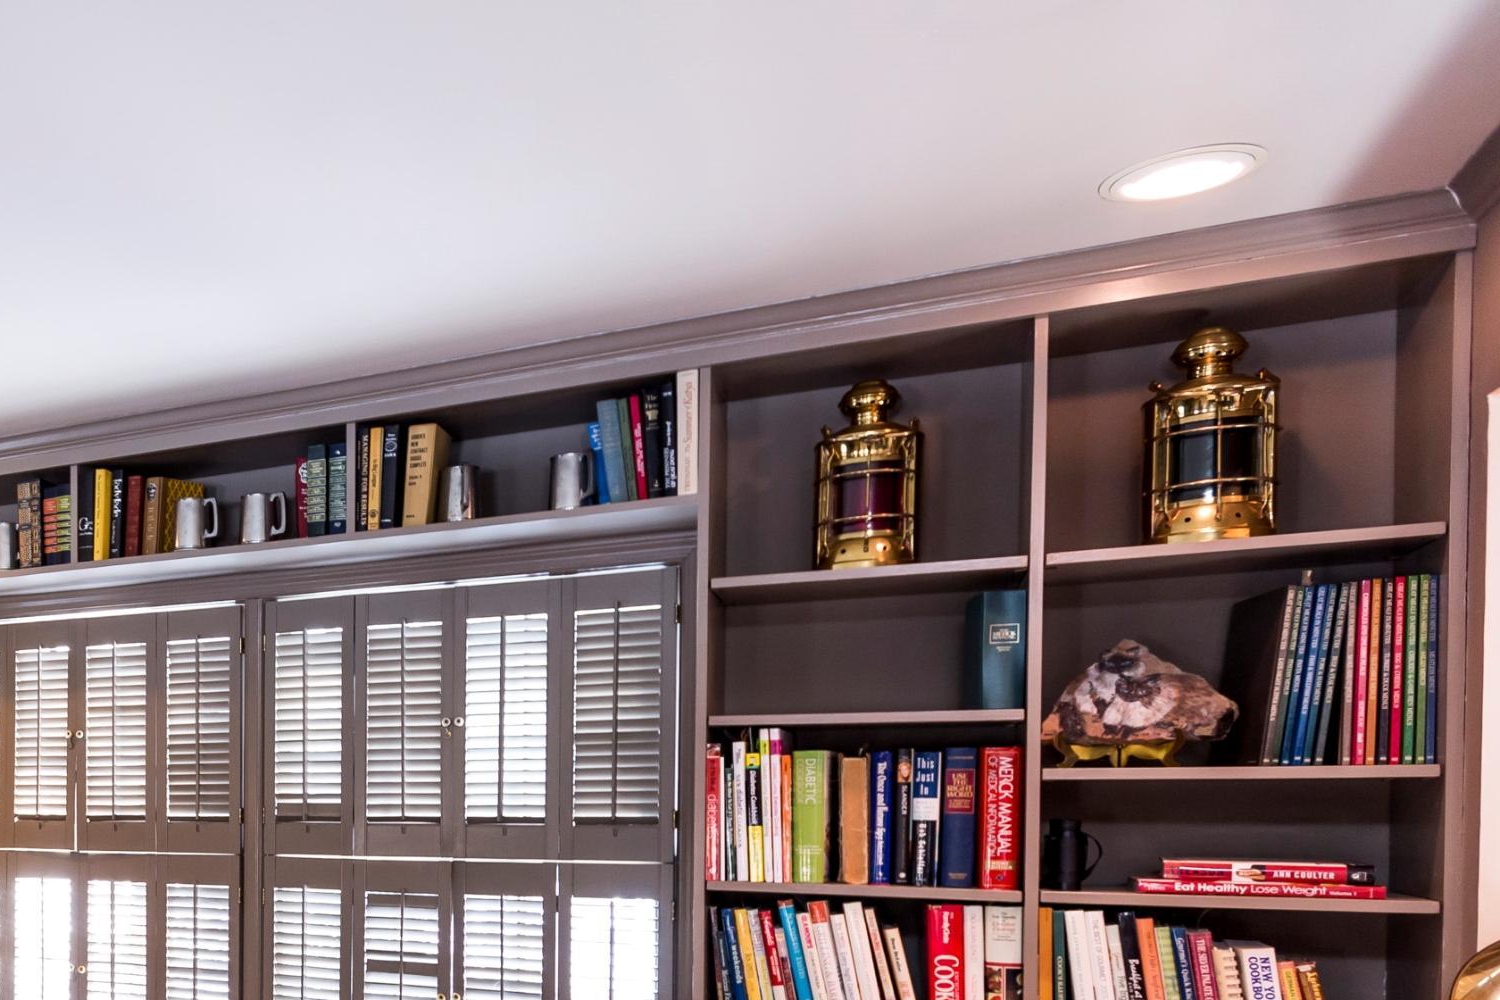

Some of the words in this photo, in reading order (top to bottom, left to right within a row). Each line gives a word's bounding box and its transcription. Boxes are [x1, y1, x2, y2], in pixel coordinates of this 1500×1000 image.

[917, 757, 935, 769] This
[988, 756, 998, 769] OF
[804, 758, 817, 805] DIABETIC
[876, 775, 887, 792] Once
[916, 771, 934, 782] Just
[987, 769, 998, 802] MEDICAL
[998, 756, 1014, 799] MERCK
[920, 783, 929, 795] In
[750, 795, 758, 824] Cookbook
[987, 803, 997, 857] INFORMATION
[997, 802, 1013, 856] MANUAL
[1272, 870, 1291, 879] ANN
[1293, 870, 1335, 880] COULTER
[1174, 881, 1195, 892] Eat
[1198, 882, 1248, 895] Healthy
[1250, 884, 1278, 894] Lose
[1282, 885, 1327, 897] Weight
[1176, 937, 1187, 968] Gourmet's
[1195, 939, 1206, 952] THE
[731, 944, 743, 984] weekends
[1128, 958, 1142, 990] Breakfast
[1197, 953, 1209, 974] SILVER
[1259, 957, 1274, 983] NEW
[1117, 975, 1126, 990] Five
[1181, 969, 1192, 987] Quick
[1202, 974, 1212, 997] PALATE
